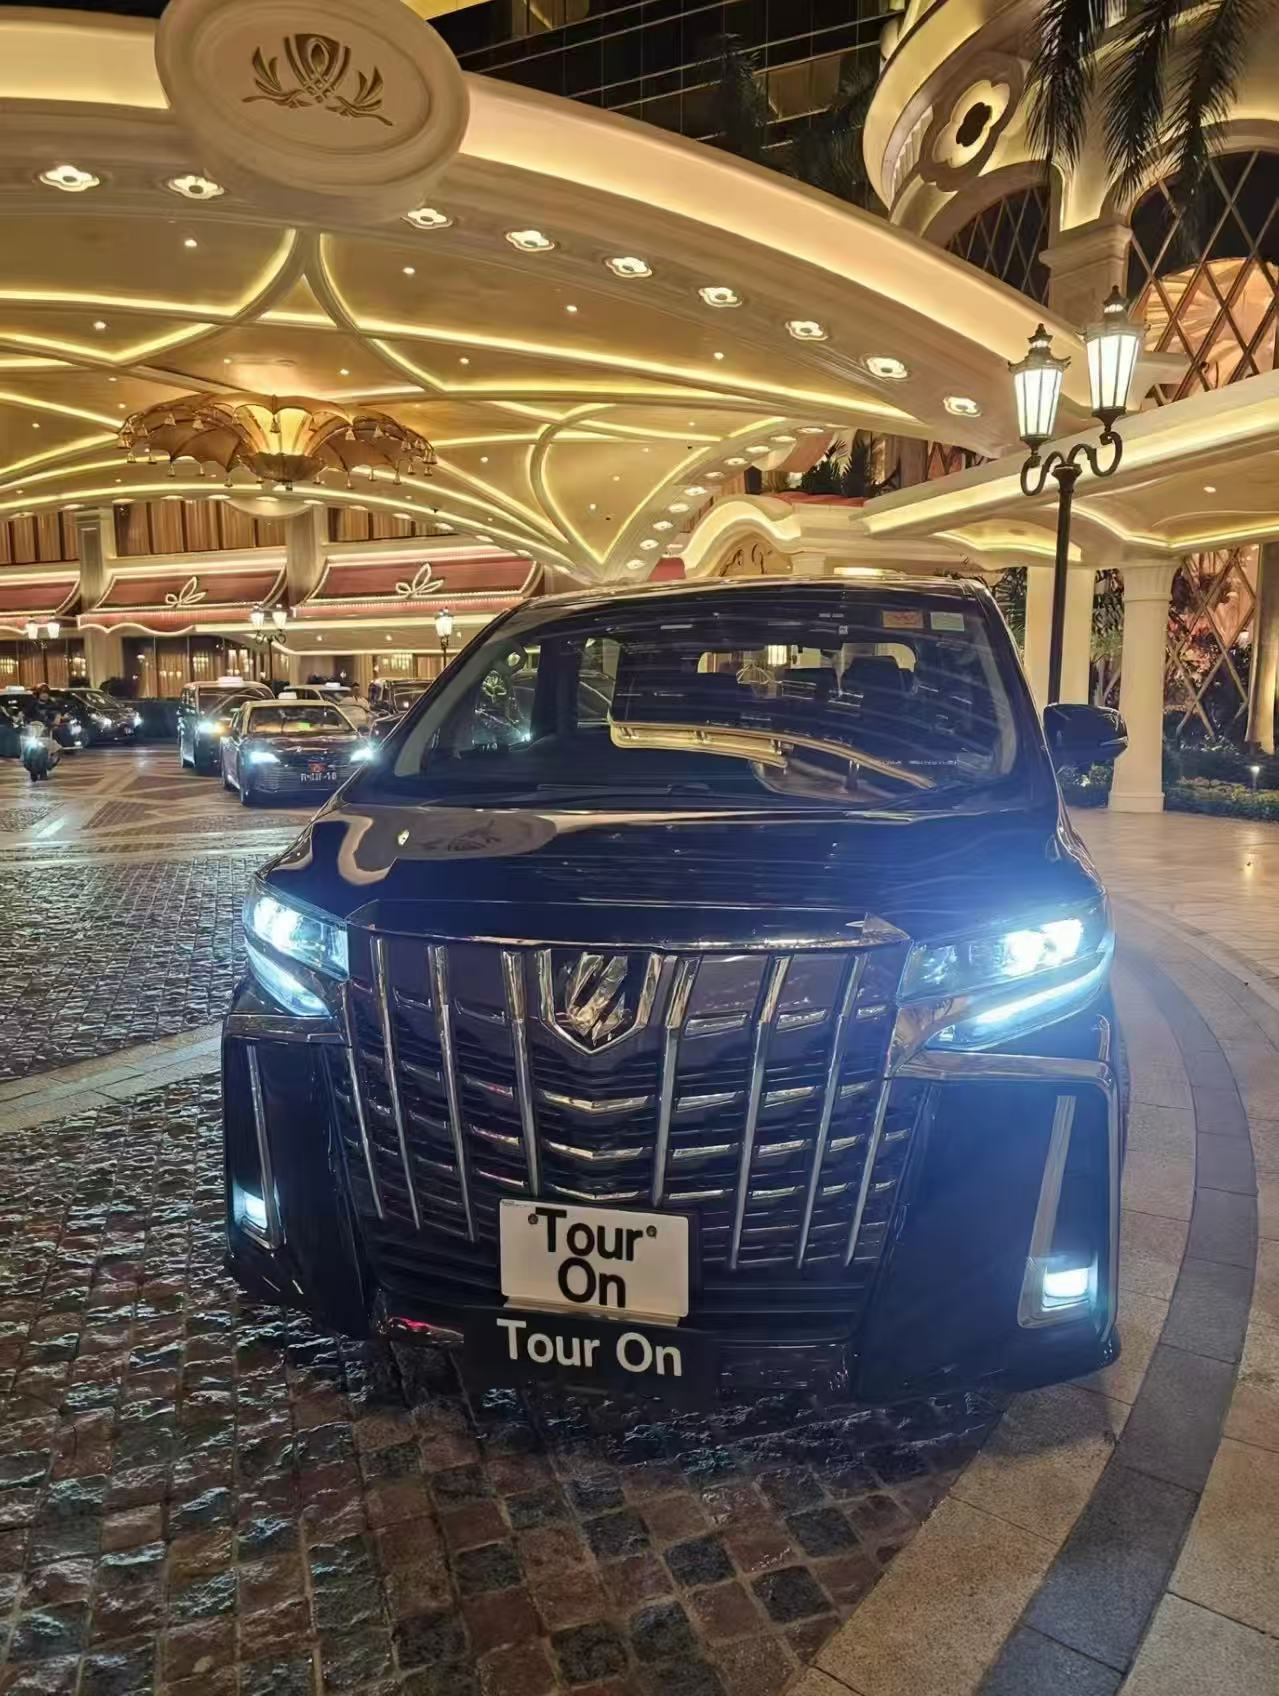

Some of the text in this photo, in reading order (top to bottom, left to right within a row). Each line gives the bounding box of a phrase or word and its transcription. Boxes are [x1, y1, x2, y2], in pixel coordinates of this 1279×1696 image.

[535, 1207, 643, 1261] Tour
[557, 1257, 626, 1308] On
[496, 1318, 682, 1377] Tour On
